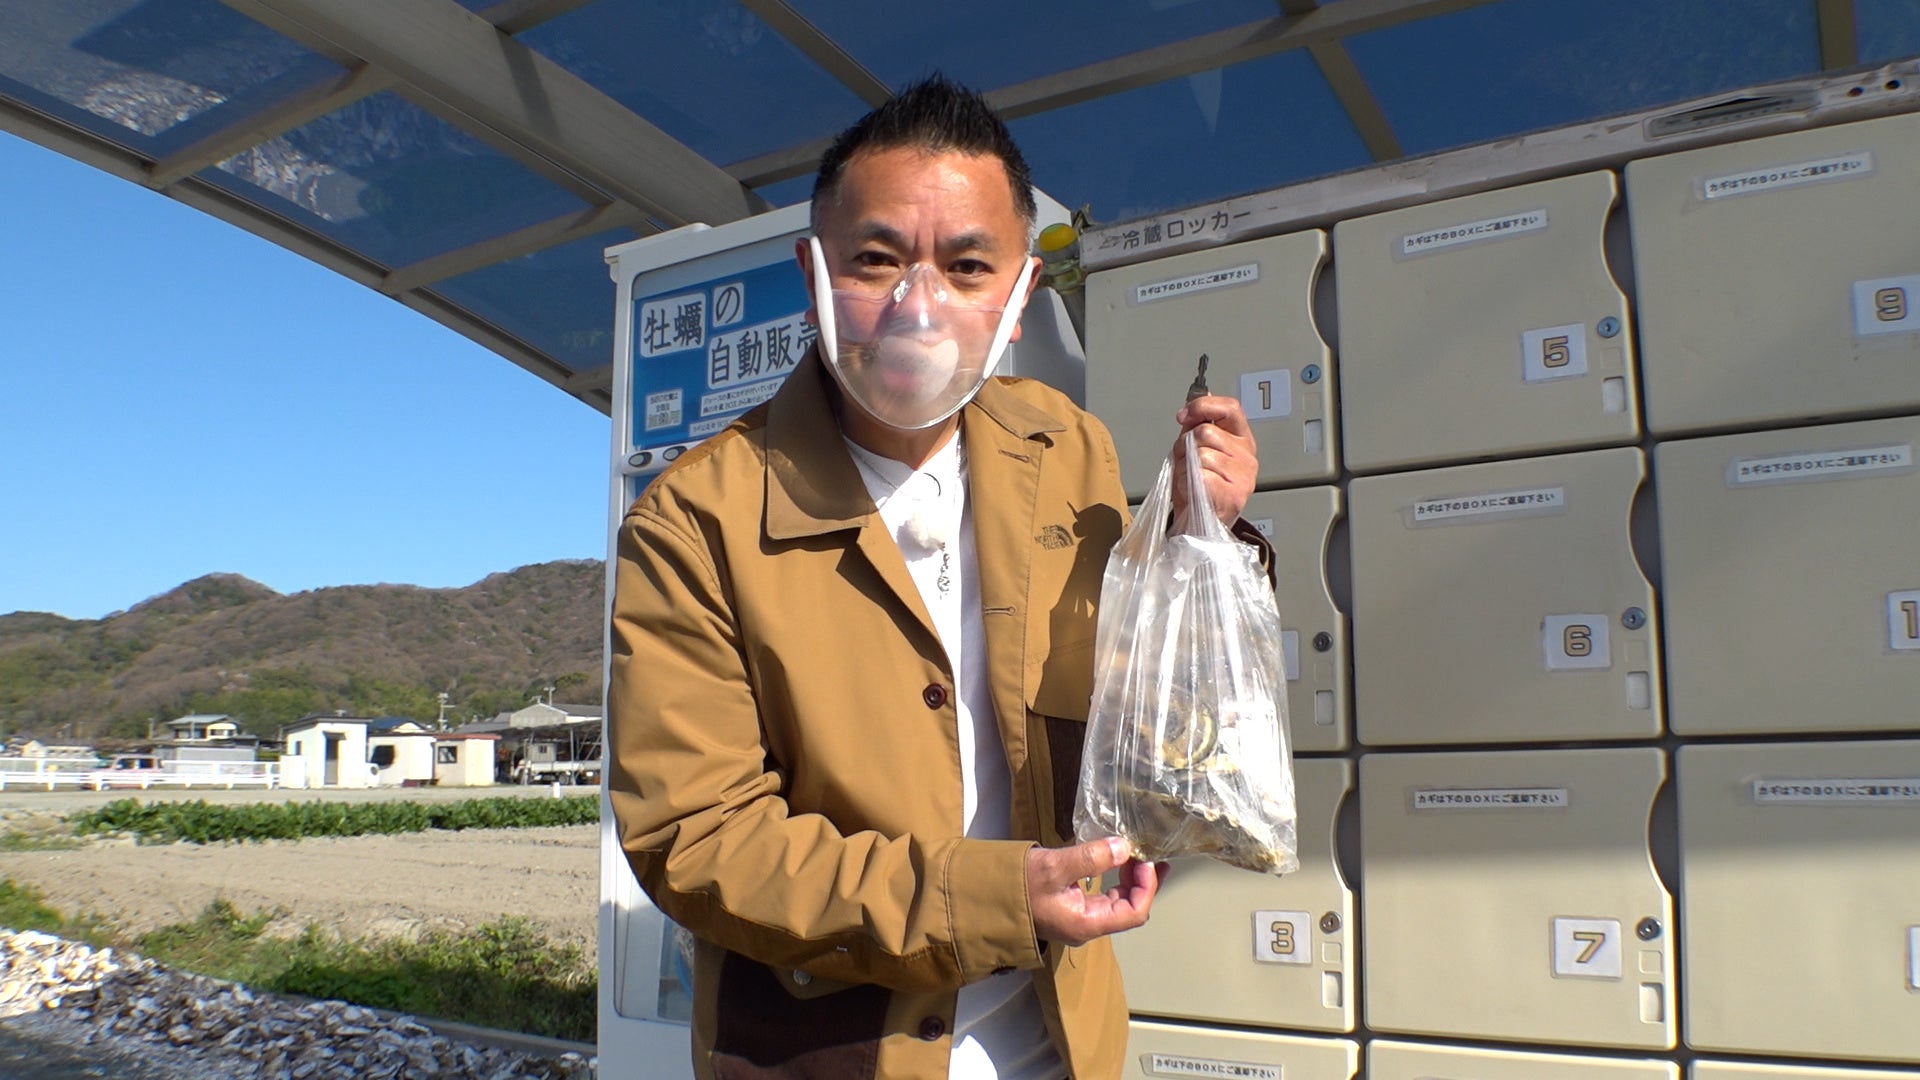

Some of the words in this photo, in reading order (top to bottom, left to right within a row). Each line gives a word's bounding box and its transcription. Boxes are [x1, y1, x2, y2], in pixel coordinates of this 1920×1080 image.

[1122, 210, 1252, 250] 冷蔵ロッカー
[1875, 286, 1908, 321] 9
[1542, 335, 1570, 369] 5
[1257, 380, 1272, 410] 1
[1563, 624, 1592, 657] 6
[1270, 920, 1295, 955] 3
[1572, 930, 1606, 964] 7
